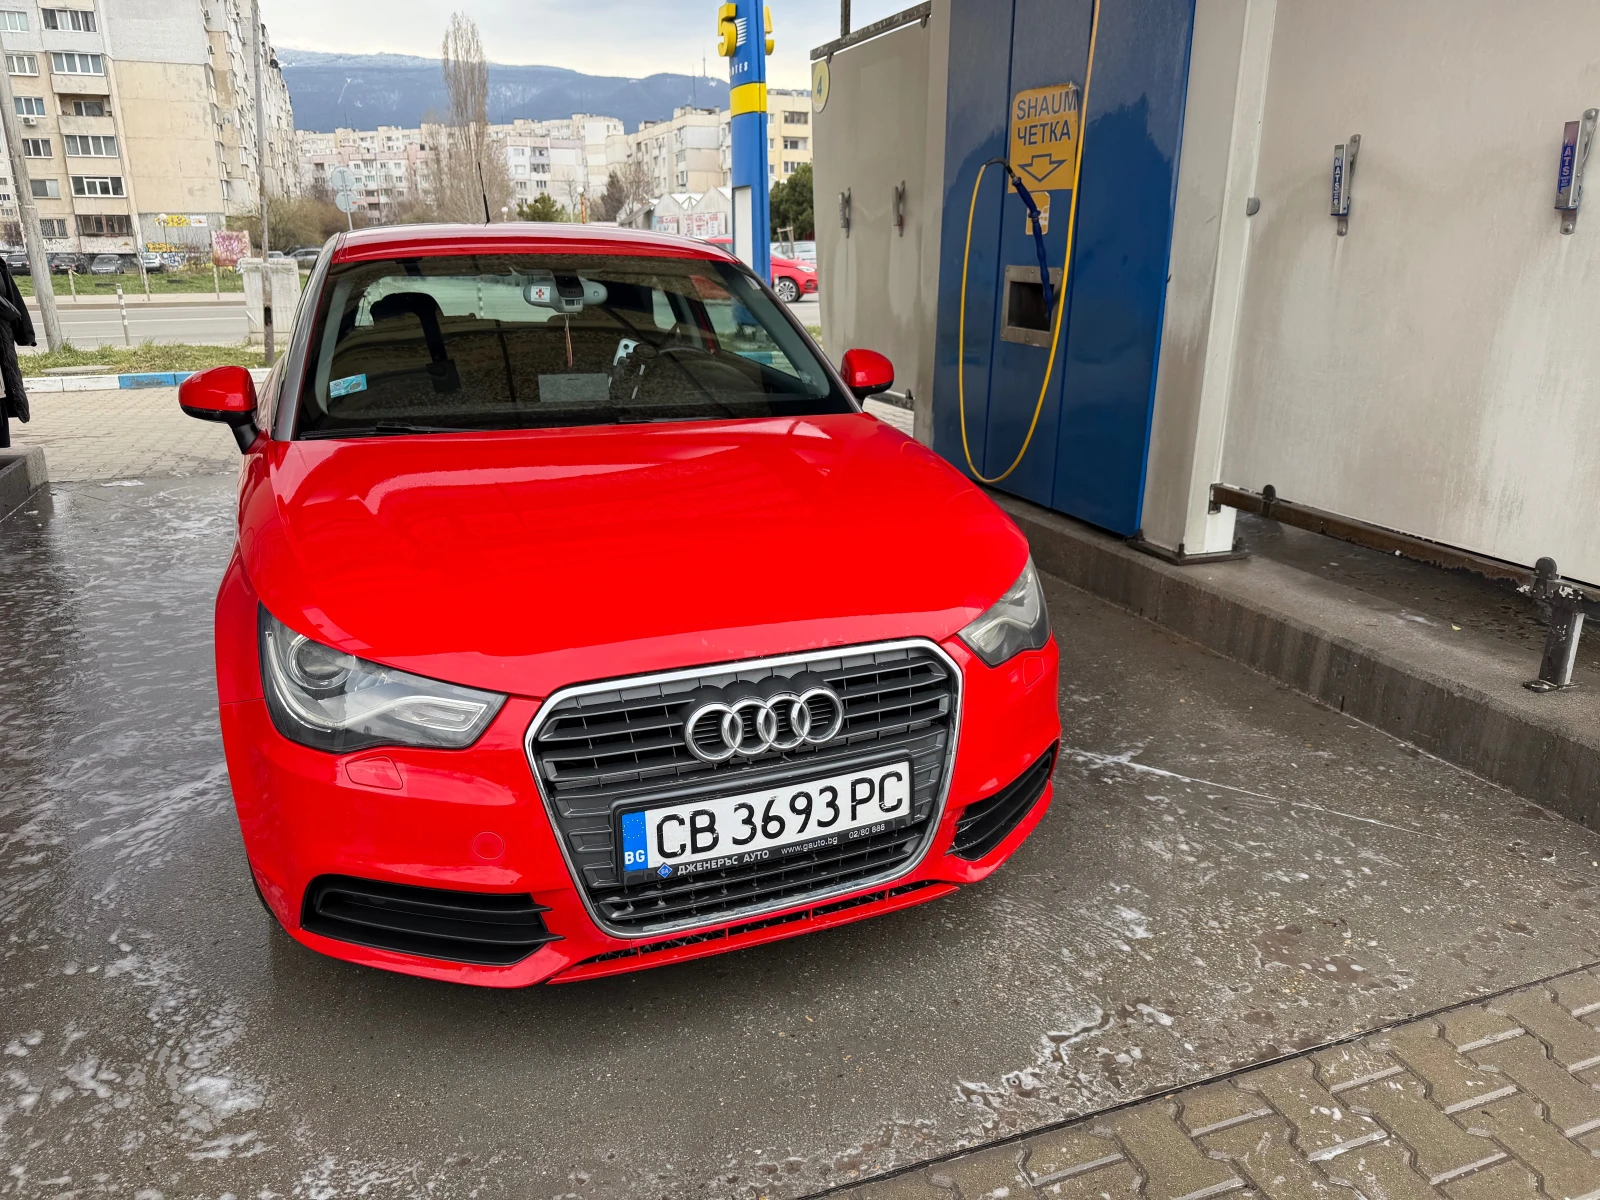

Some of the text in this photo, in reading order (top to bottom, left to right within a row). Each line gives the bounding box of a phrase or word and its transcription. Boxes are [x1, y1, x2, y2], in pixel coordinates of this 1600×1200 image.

[816, 75, 823, 97] 4
[1016, 90, 1078, 121] SHAUM
[1017, 119, 1071, 146] ЧЕТКА
[656, 770, 903, 859] CB 3693 PC
[848, 823, 886, 839] 02/80 888
[624, 850, 645, 865] BG
[780, 836, 838, 855] www.gauto.bg
[677, 850, 769, 876] ДЖЕНЕРЪС АУТО
